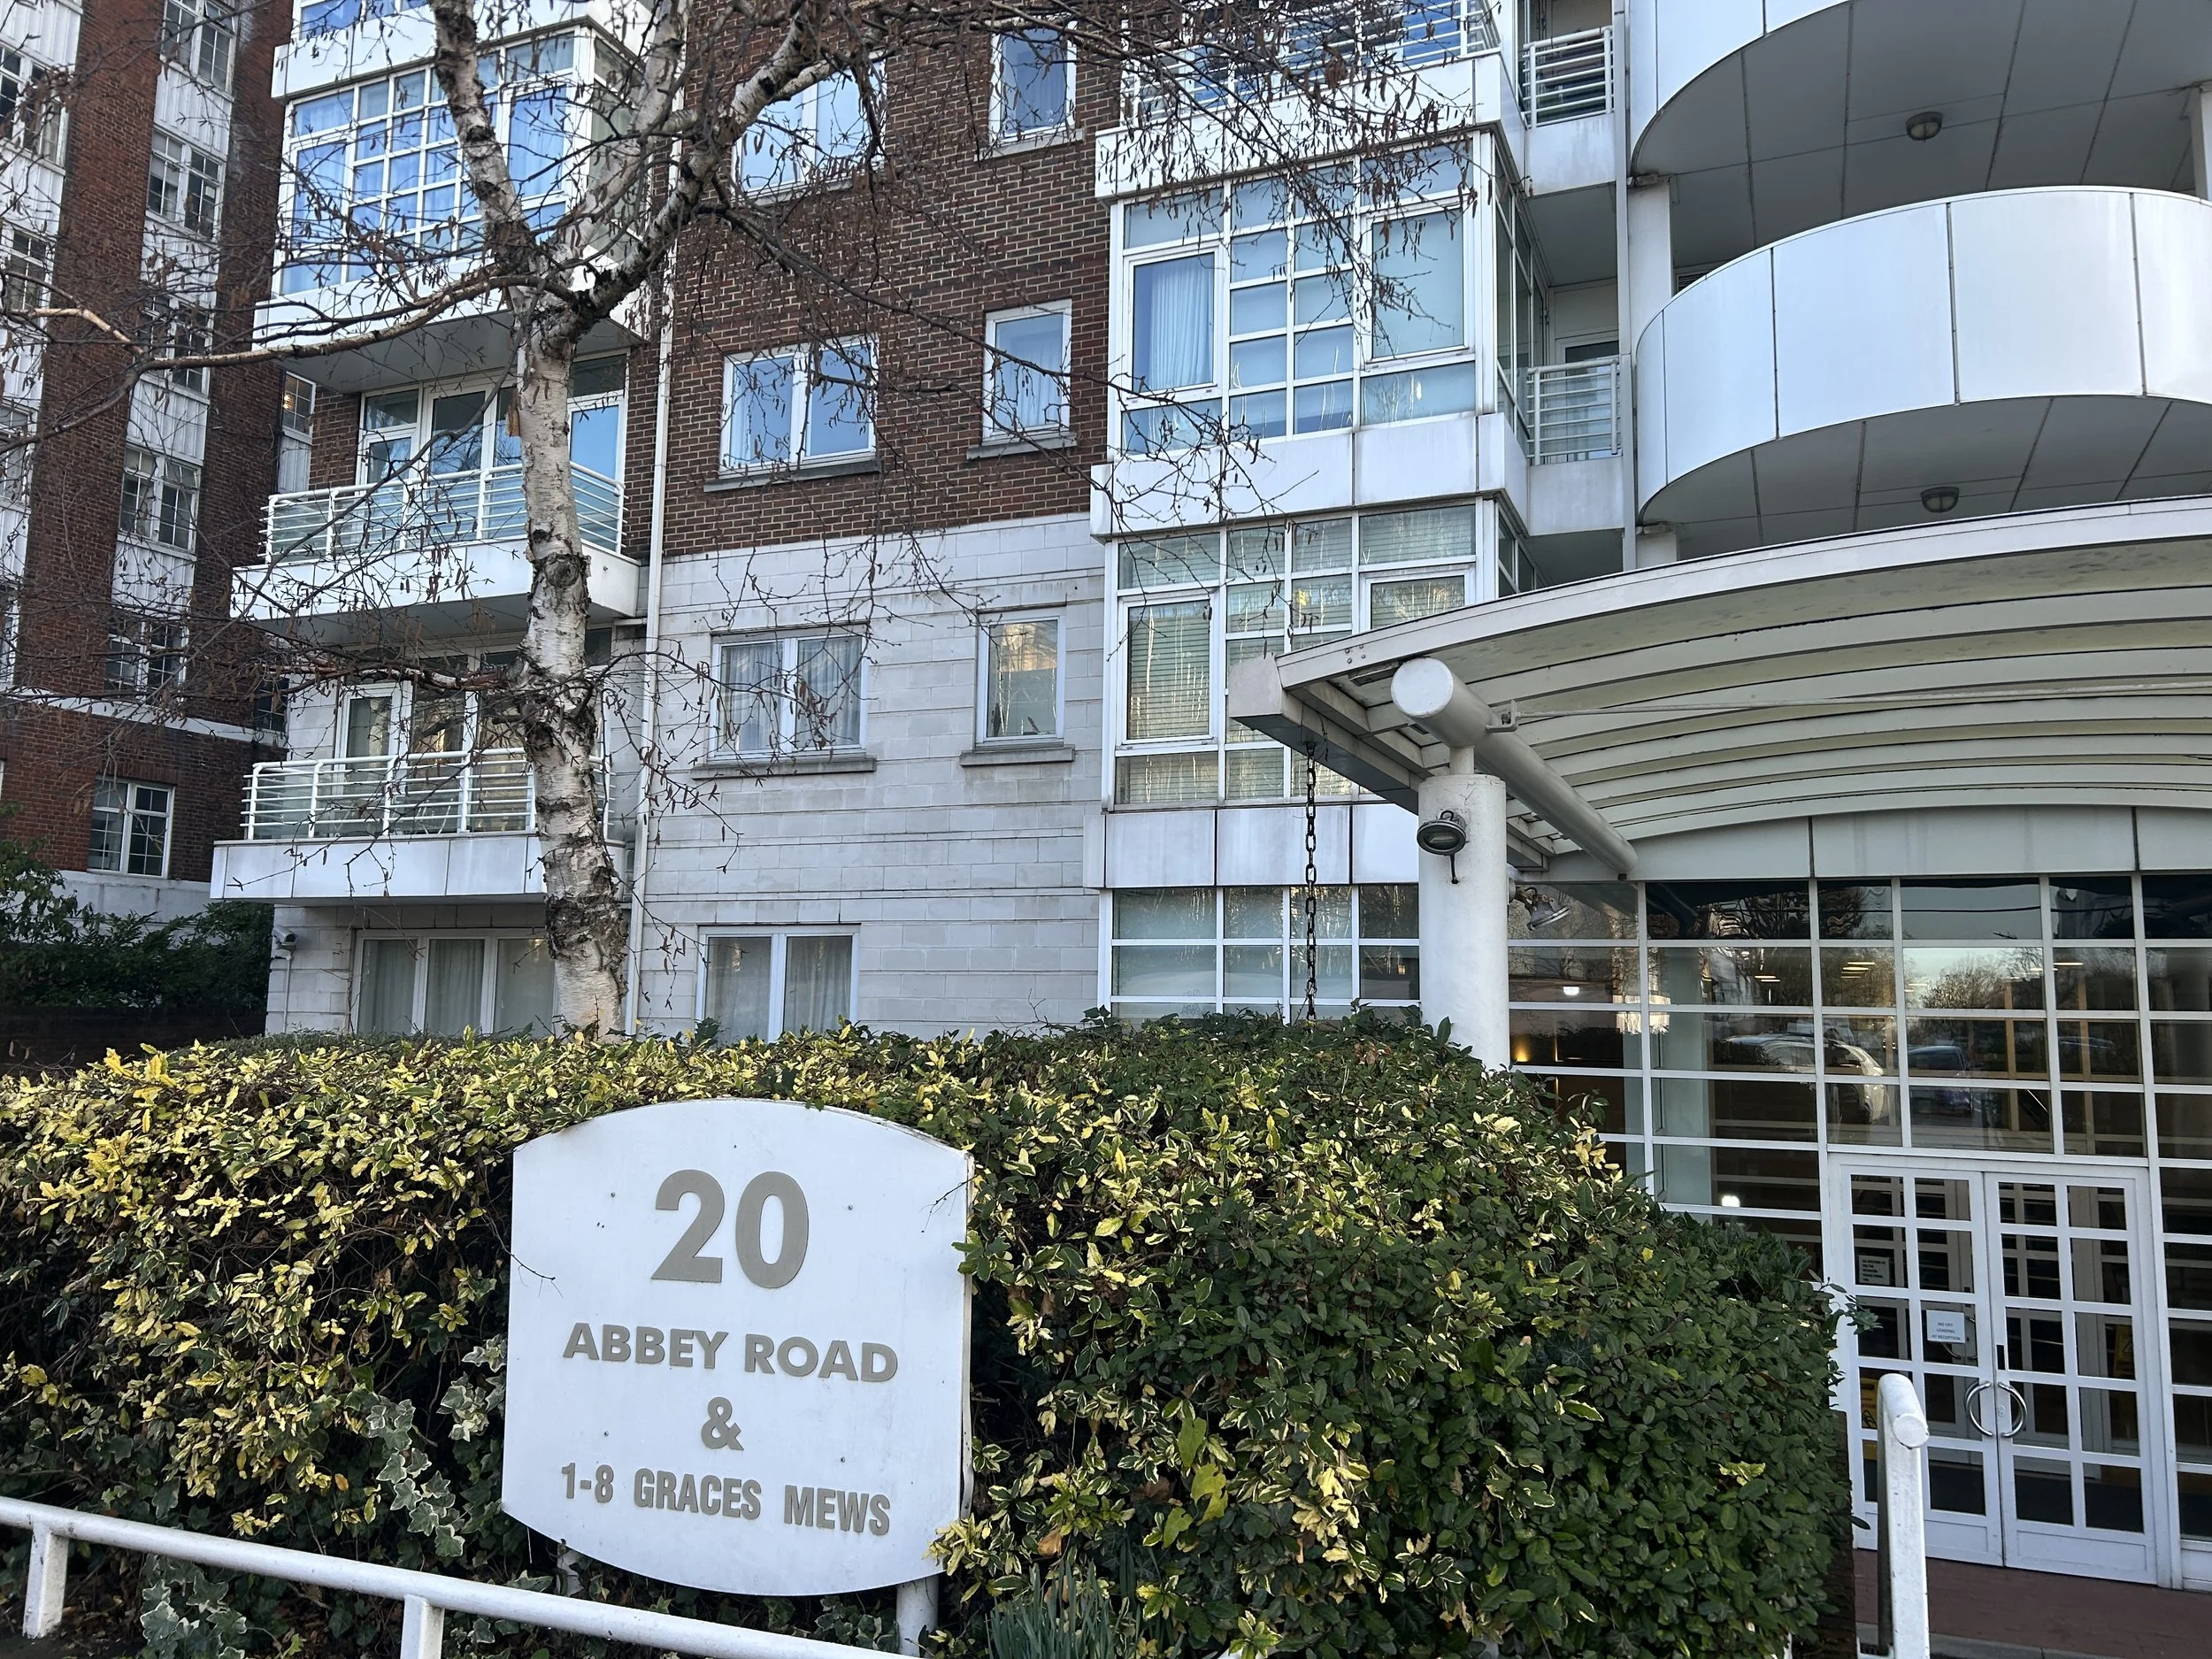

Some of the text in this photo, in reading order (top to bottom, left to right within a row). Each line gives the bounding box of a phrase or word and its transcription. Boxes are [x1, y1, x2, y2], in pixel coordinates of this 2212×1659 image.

[649, 1169, 810, 1290] 20
[562, 1322, 899, 1384] ABBEY ROAD
[700, 1396, 745, 1452] &
[560, 1462, 891, 1538] 1-8 GRACES MEWS
